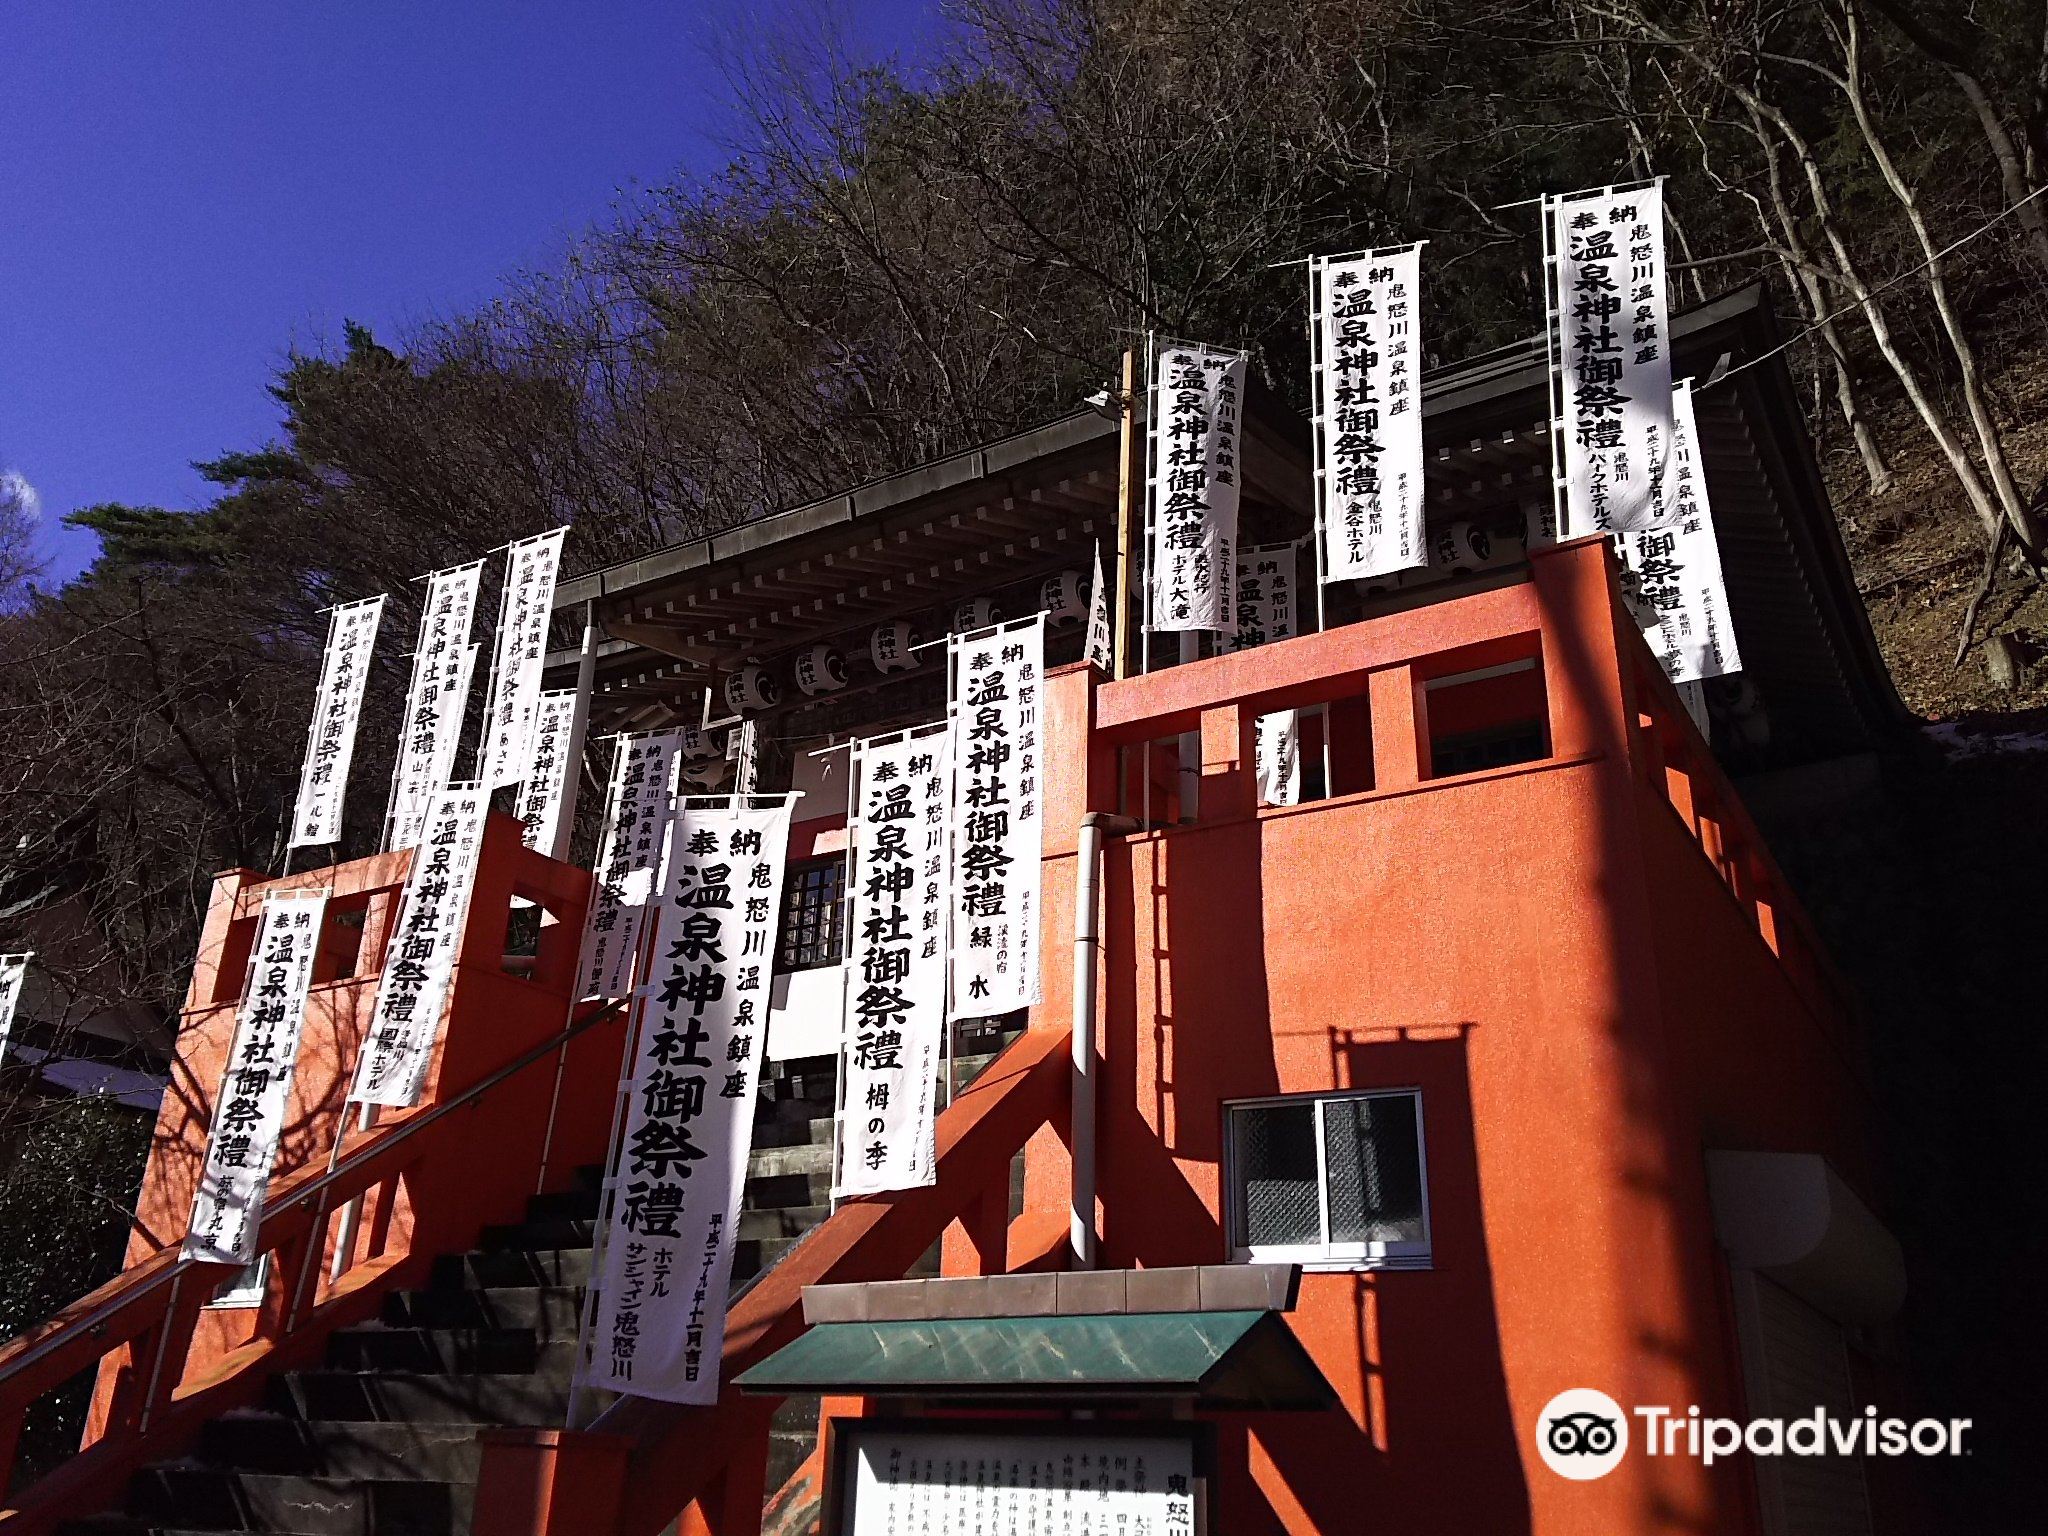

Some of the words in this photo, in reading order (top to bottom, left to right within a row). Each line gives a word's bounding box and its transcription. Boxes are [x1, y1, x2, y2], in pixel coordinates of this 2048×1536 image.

[1334, 267, 1394, 288] 奉納
[1570, 205, 1637, 230] 奉納
[1387, 284, 1409, 416] 鬼怒川温泉鎮座
[1570, 231, 1632, 448] 温泉神社御祭禮
[1630, 224, 1659, 365] 鬼怒川温泉鎮座
[1171, 354, 1225, 371] 奉納
[1333, 289, 1386, 495] 温泉神社御祭禮
[1164, 369, 1212, 550] 温泉神社御祭禮
[1368, 500, 1382, 535] 鬼怒川
[1614, 453, 1629, 482] 鬼怒川
[1170, 555, 1190, 620] ホテル大滝
[1345, 502, 1364, 564] 金谷ホテル
[311, 629, 358, 784] 温泉神社御祭禮
[970, 644, 1024, 671] 奉納
[440, 800, 475, 815] 奉納
[873, 754, 932, 782] 奉納
[961, 671, 1015, 917] 温泉神社御祭禮
[1018, 664, 1036, 821] 鬼怒川温泉鎮座
[685, 829, 762, 857] 奉納
[920, 777, 943, 958] 鬼怒川温泉鎮座
[273, 912, 310, 928] 奉納
[381, 819, 458, 1023] 温泉神社御祭禮
[719, 863, 772, 1098] 鬼怒川温泉鎮座
[854, 784, 915, 1070] 温泉神社御祭禮
[969, 926, 992, 999] 緑水
[213, 934, 294, 1168] 温泉神社御祭禮
[621, 863, 734, 1239] 温泉神社御祭禮
[611, 1243, 646, 1381] サンシャイン鬼怒川
[650, 1248, 673, 1297] ホテル
[684, 1213, 722, 1381] 平成二十九年十一月吉日
